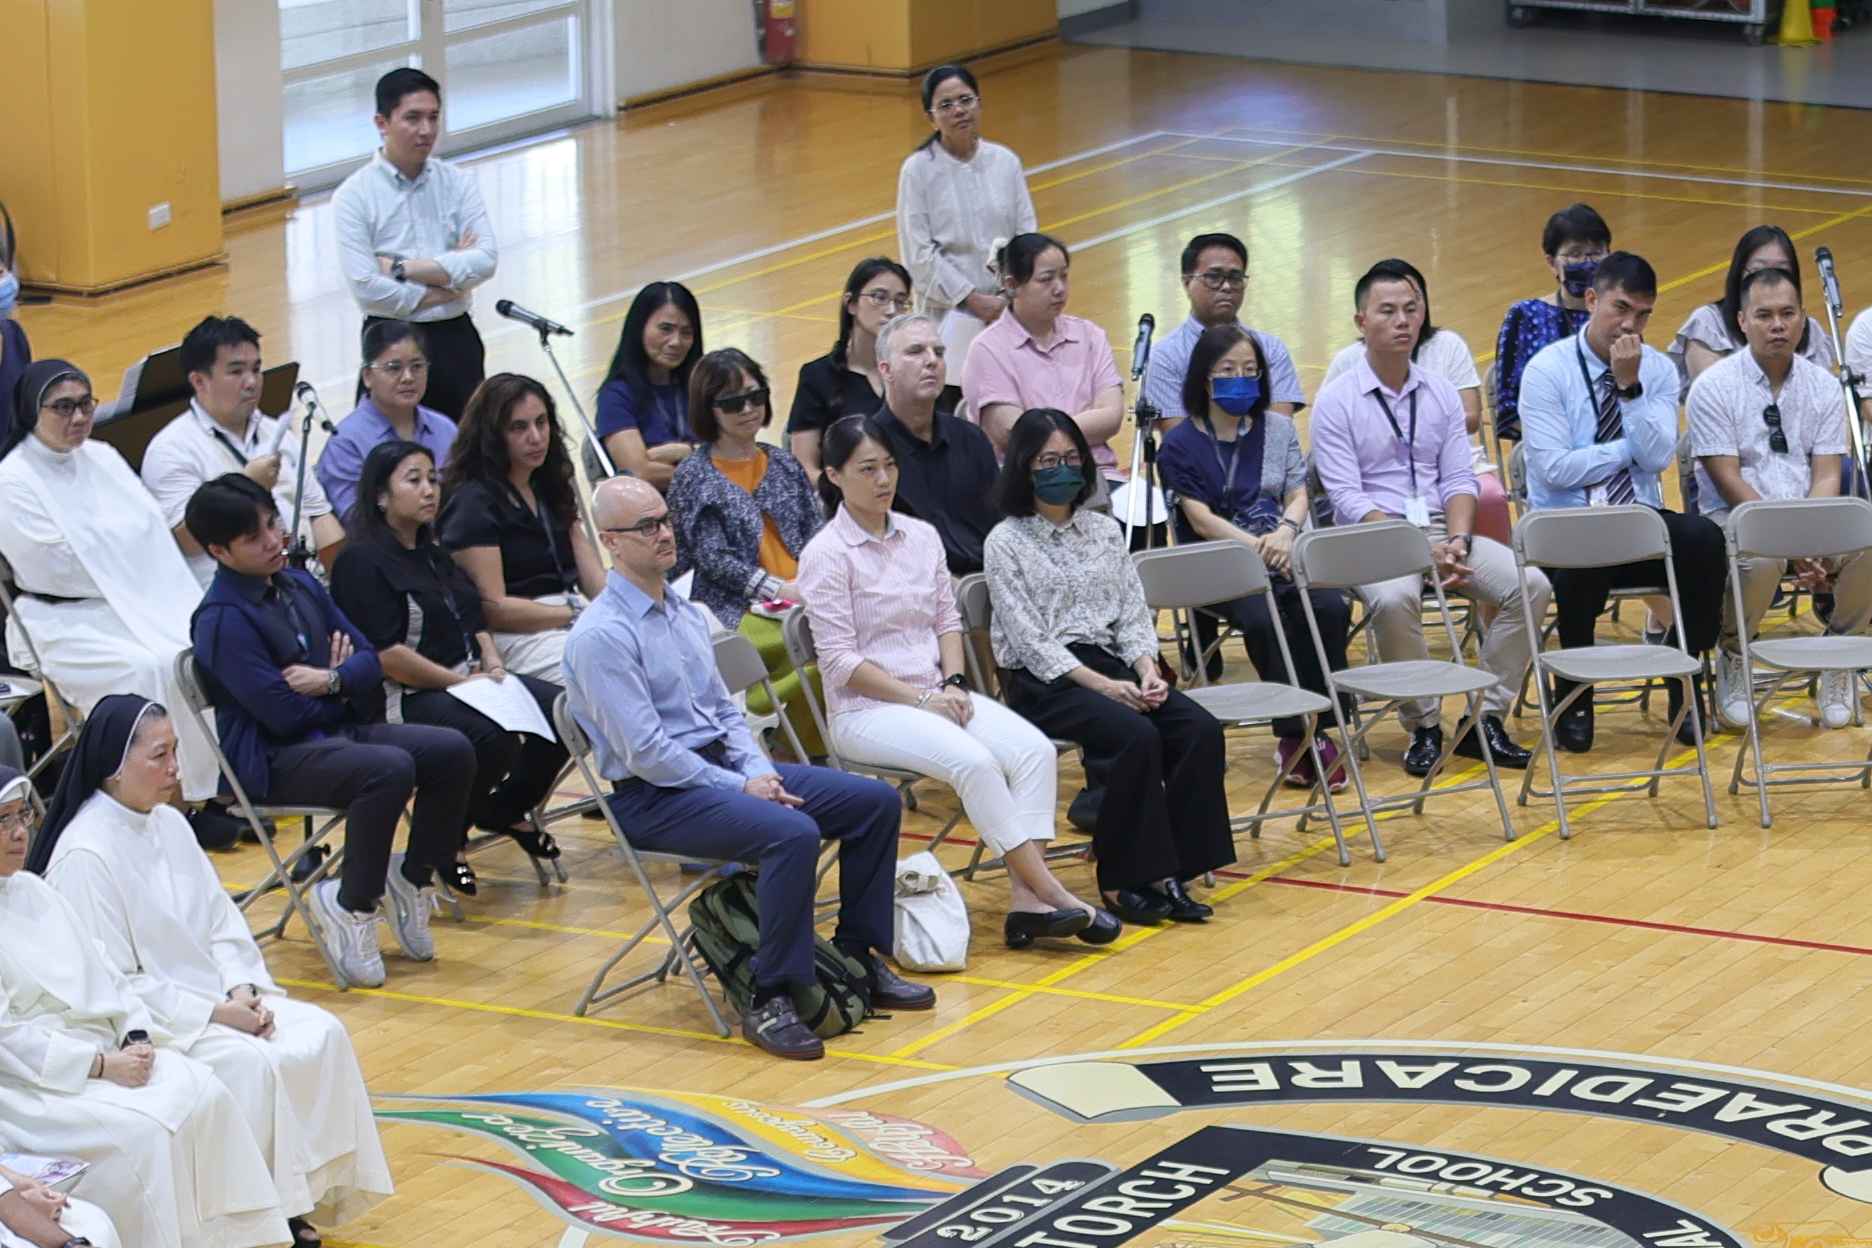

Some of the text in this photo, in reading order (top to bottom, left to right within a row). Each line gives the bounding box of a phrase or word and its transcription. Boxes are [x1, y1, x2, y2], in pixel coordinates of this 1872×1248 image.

[461, 1111, 695, 1198] Organized
[586, 1096, 782, 1184] Reflective
[1364, 1146, 1615, 1208] SCHOOL
[935, 1177, 1088, 1242] 2014
